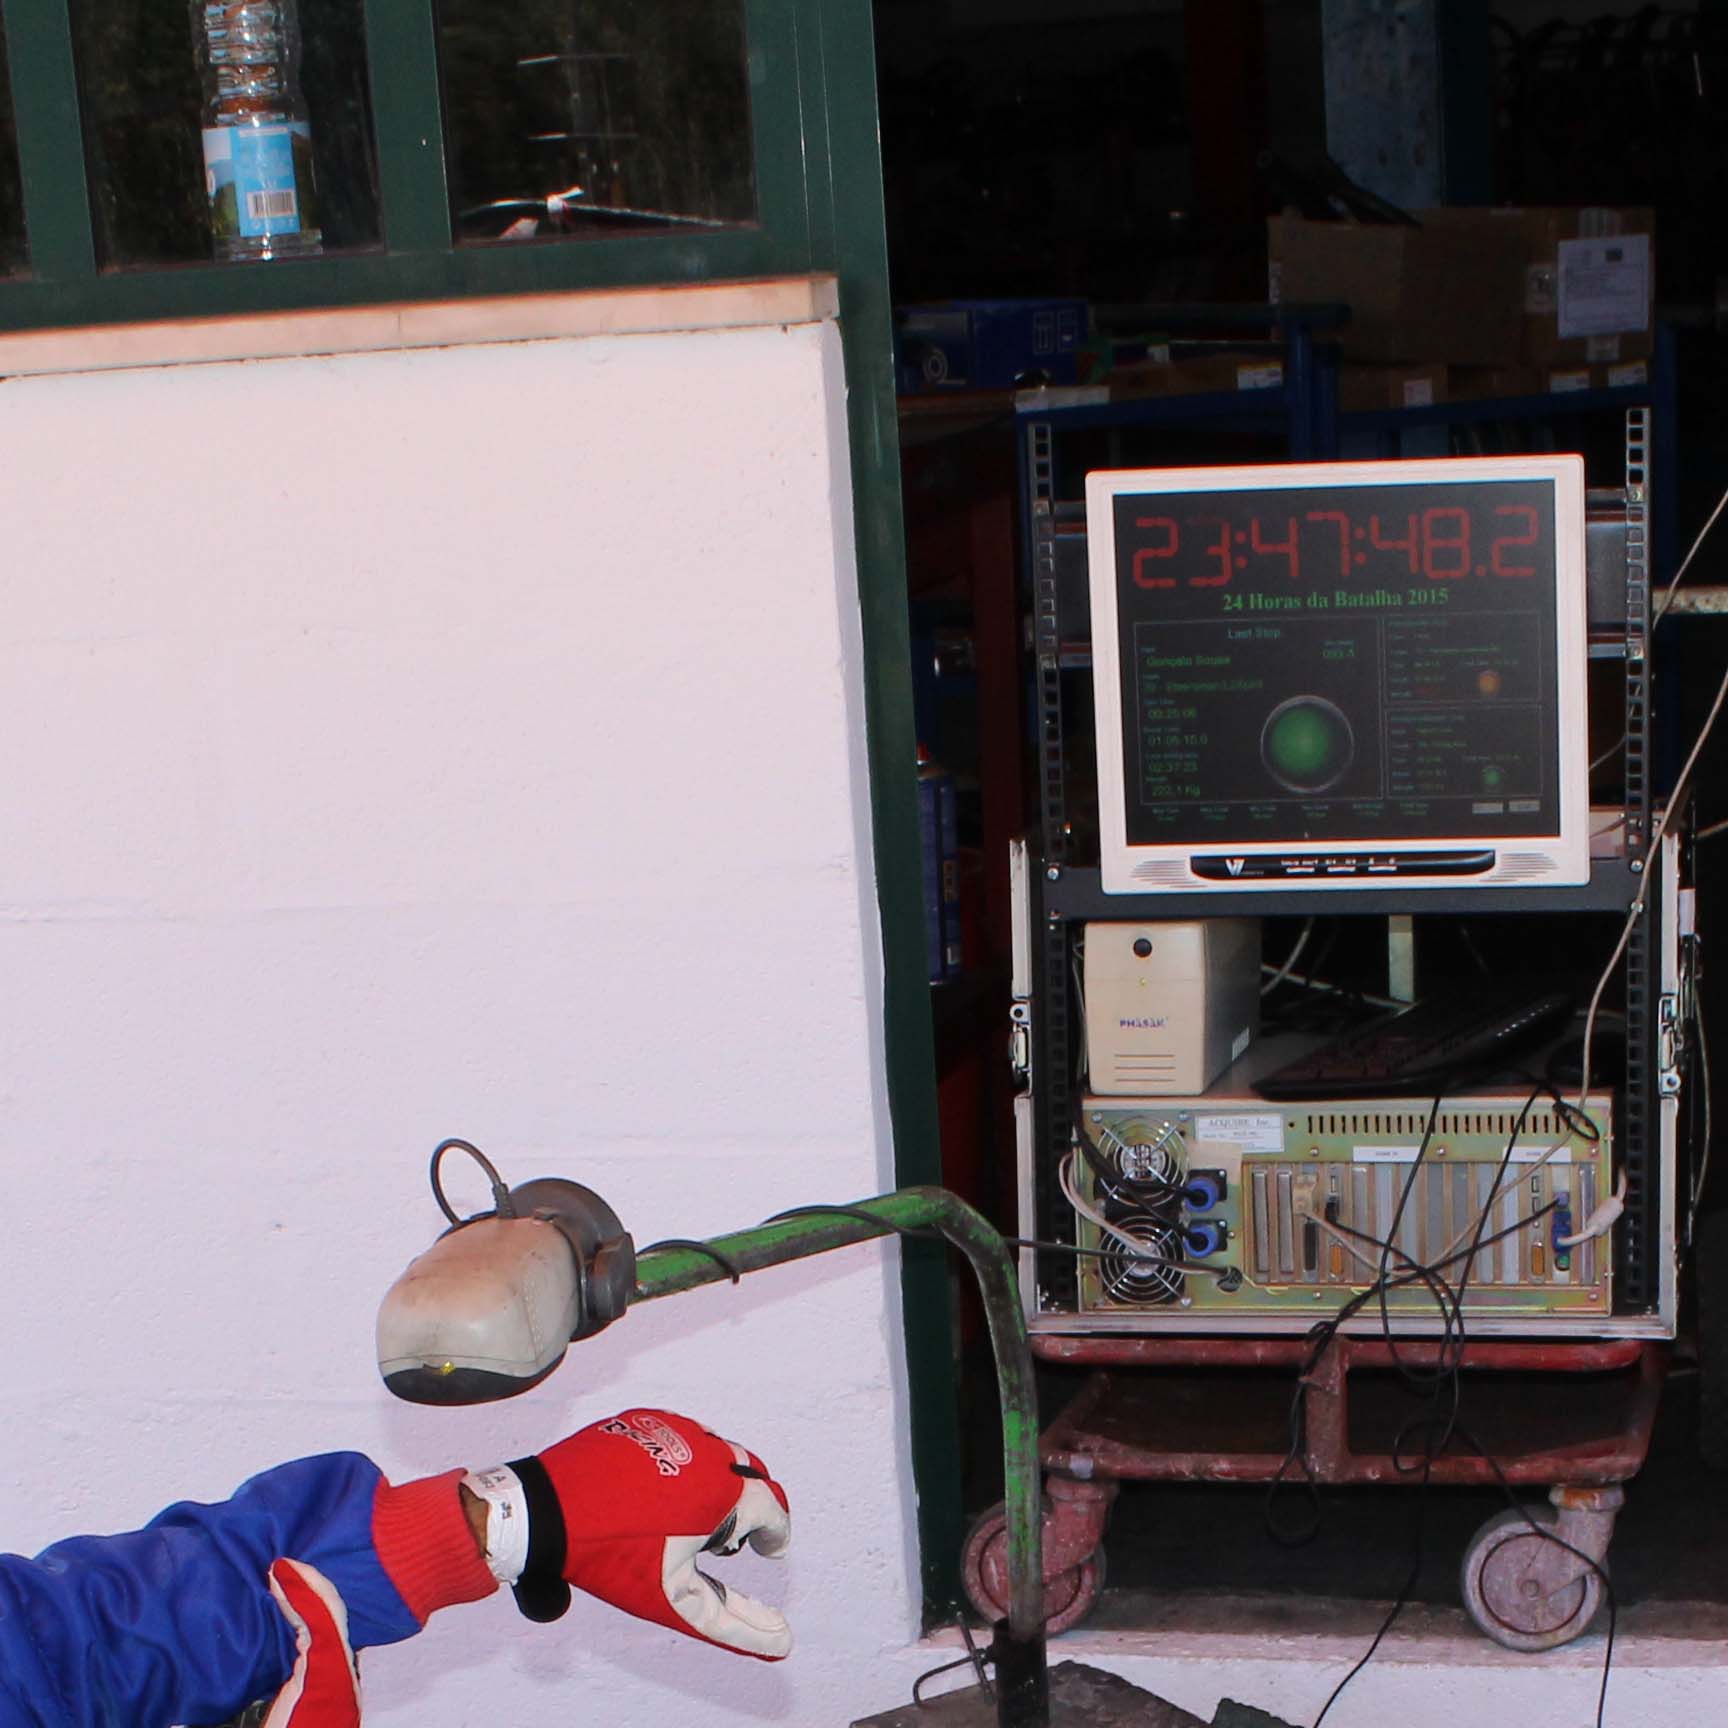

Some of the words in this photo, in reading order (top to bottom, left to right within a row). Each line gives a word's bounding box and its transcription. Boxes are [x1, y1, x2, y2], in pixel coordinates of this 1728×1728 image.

[1223, 594, 1244, 611] 24
[1249, 592, 1301, 610] Horas
[1307, 590, 1329, 609] da
[1335, 589, 1403, 609] Batalha
[1407, 587, 1450, 606] 2015
